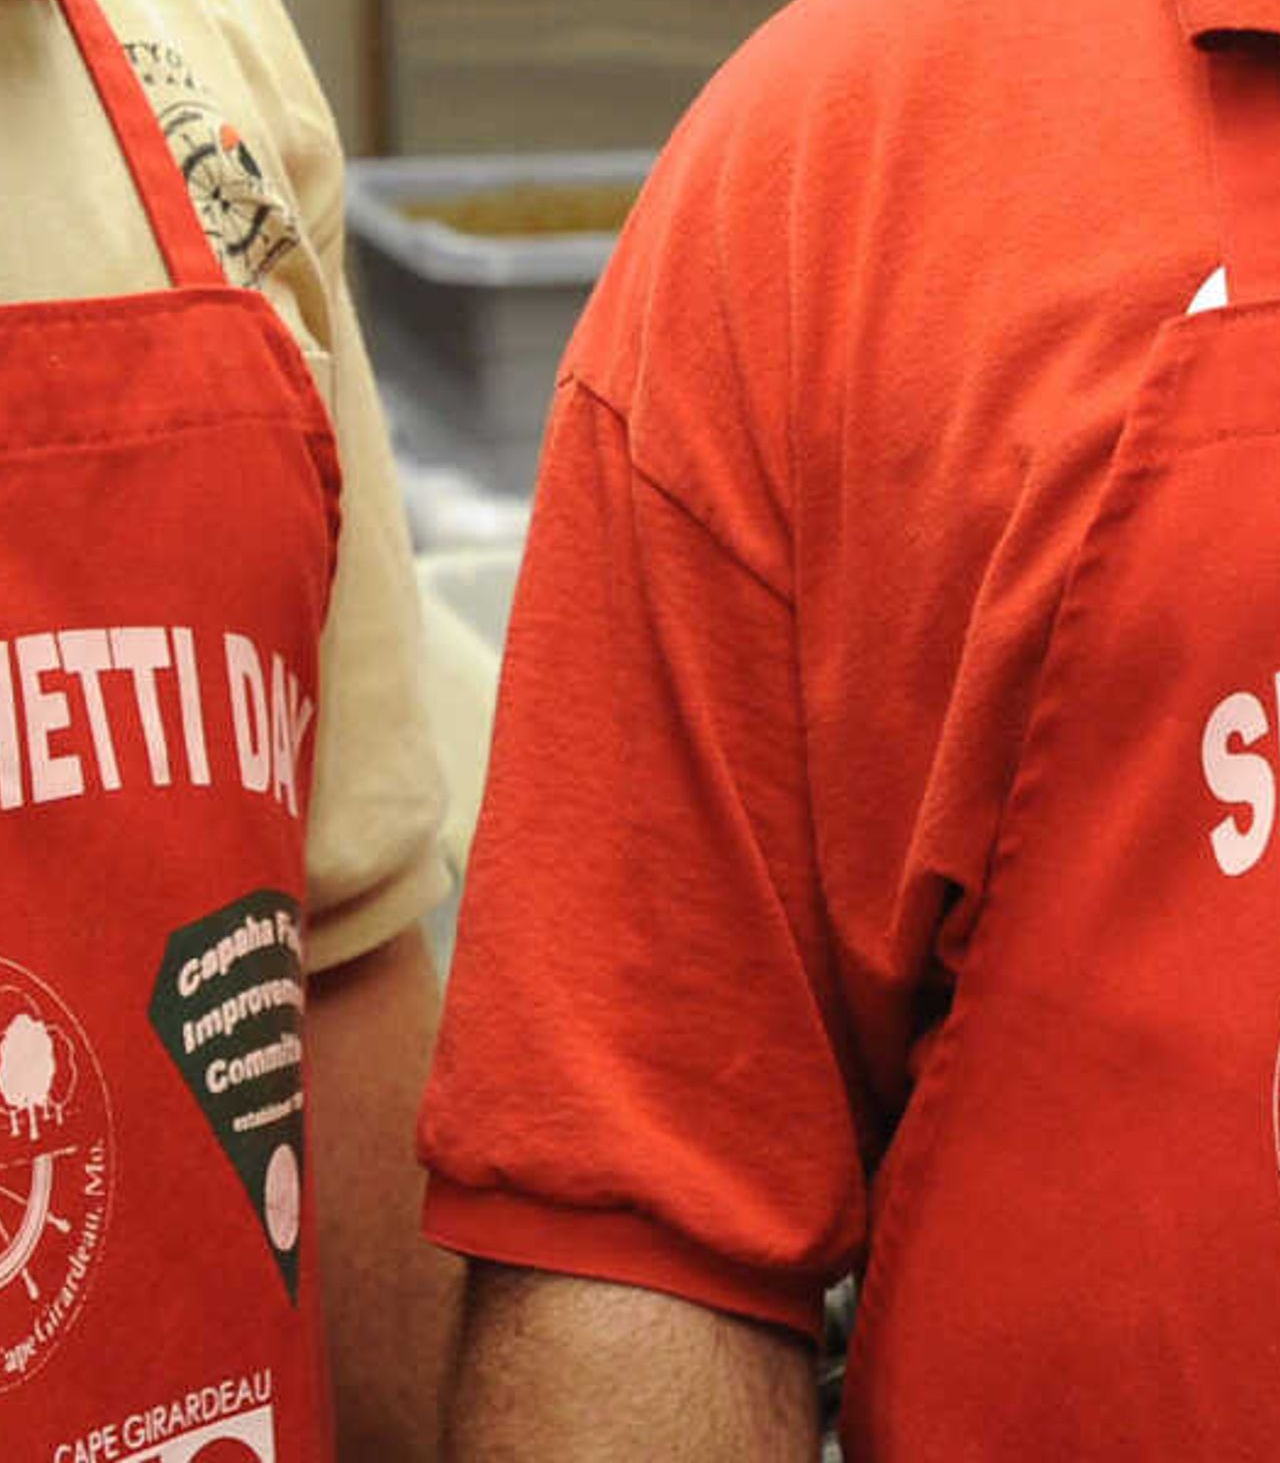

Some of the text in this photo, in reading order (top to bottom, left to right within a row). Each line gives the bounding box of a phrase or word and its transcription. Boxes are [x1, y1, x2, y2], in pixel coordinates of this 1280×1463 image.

[177, 915, 274, 998] Capaha
[53, 1367, 271, 1463] CAPE GIRARDEAU
